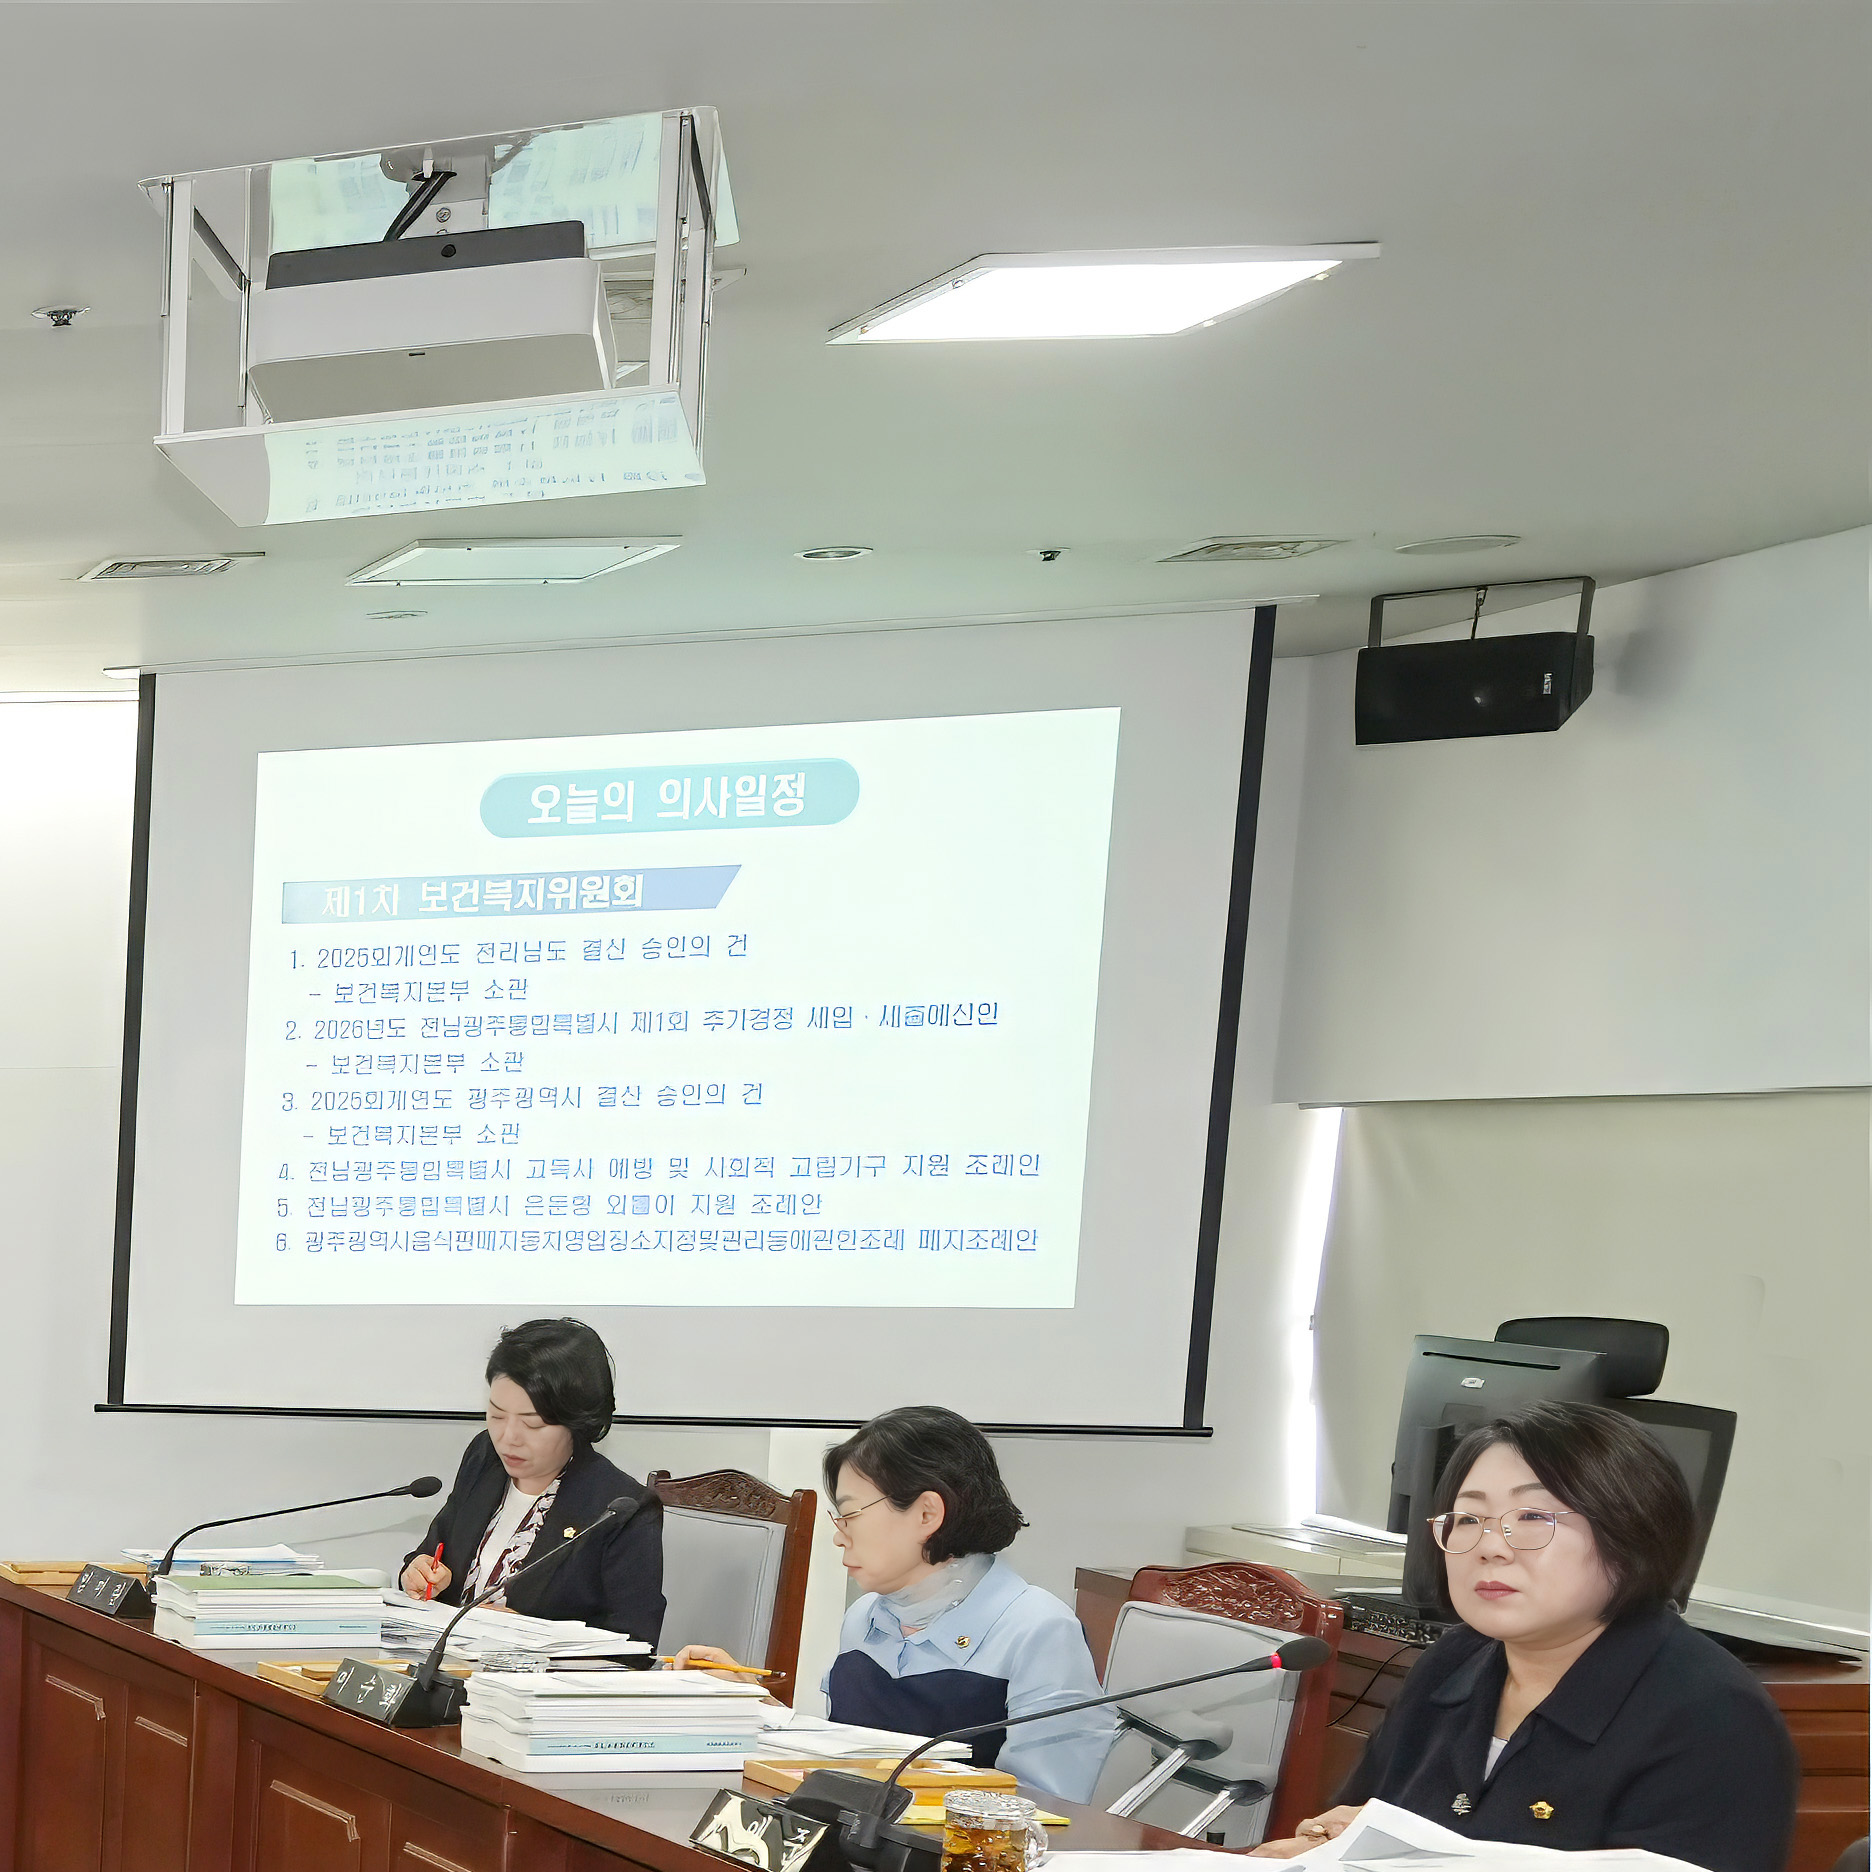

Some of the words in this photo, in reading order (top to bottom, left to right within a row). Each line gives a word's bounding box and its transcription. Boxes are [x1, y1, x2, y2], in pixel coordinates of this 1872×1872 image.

[527, 780, 635, 824] 오늘의
[656, 772, 806, 820] 의사일정
[418, 874, 645, 913] 보건복지위원회
[291, 949, 305, 969] 1.
[642, 935, 711, 959] 승인의
[728, 934, 747, 957] 건
[484, 978, 528, 1001] 소관
[285, 1020, 302, 1040] 2.
[314, 1018, 407, 1040] 2026년도
[631, 1011, 688, 1033] 제1회
[808, 1006, 853, 1029] 세입
[480, 1052, 524, 1073] 소관
[282, 1092, 298, 1111] 3.
[598, 1085, 642, 1108] 결산
[657, 1083, 726, 1107] 승인의
[742, 1083, 762, 1105] 건
[477, 1123, 520, 1145] 소관
[278, 1163, 295, 1181] 4.
[902, 1154, 949, 1177] 지원
[691, 1193, 736, 1216] 지원
[751, 1193, 823, 1216] 조례안
